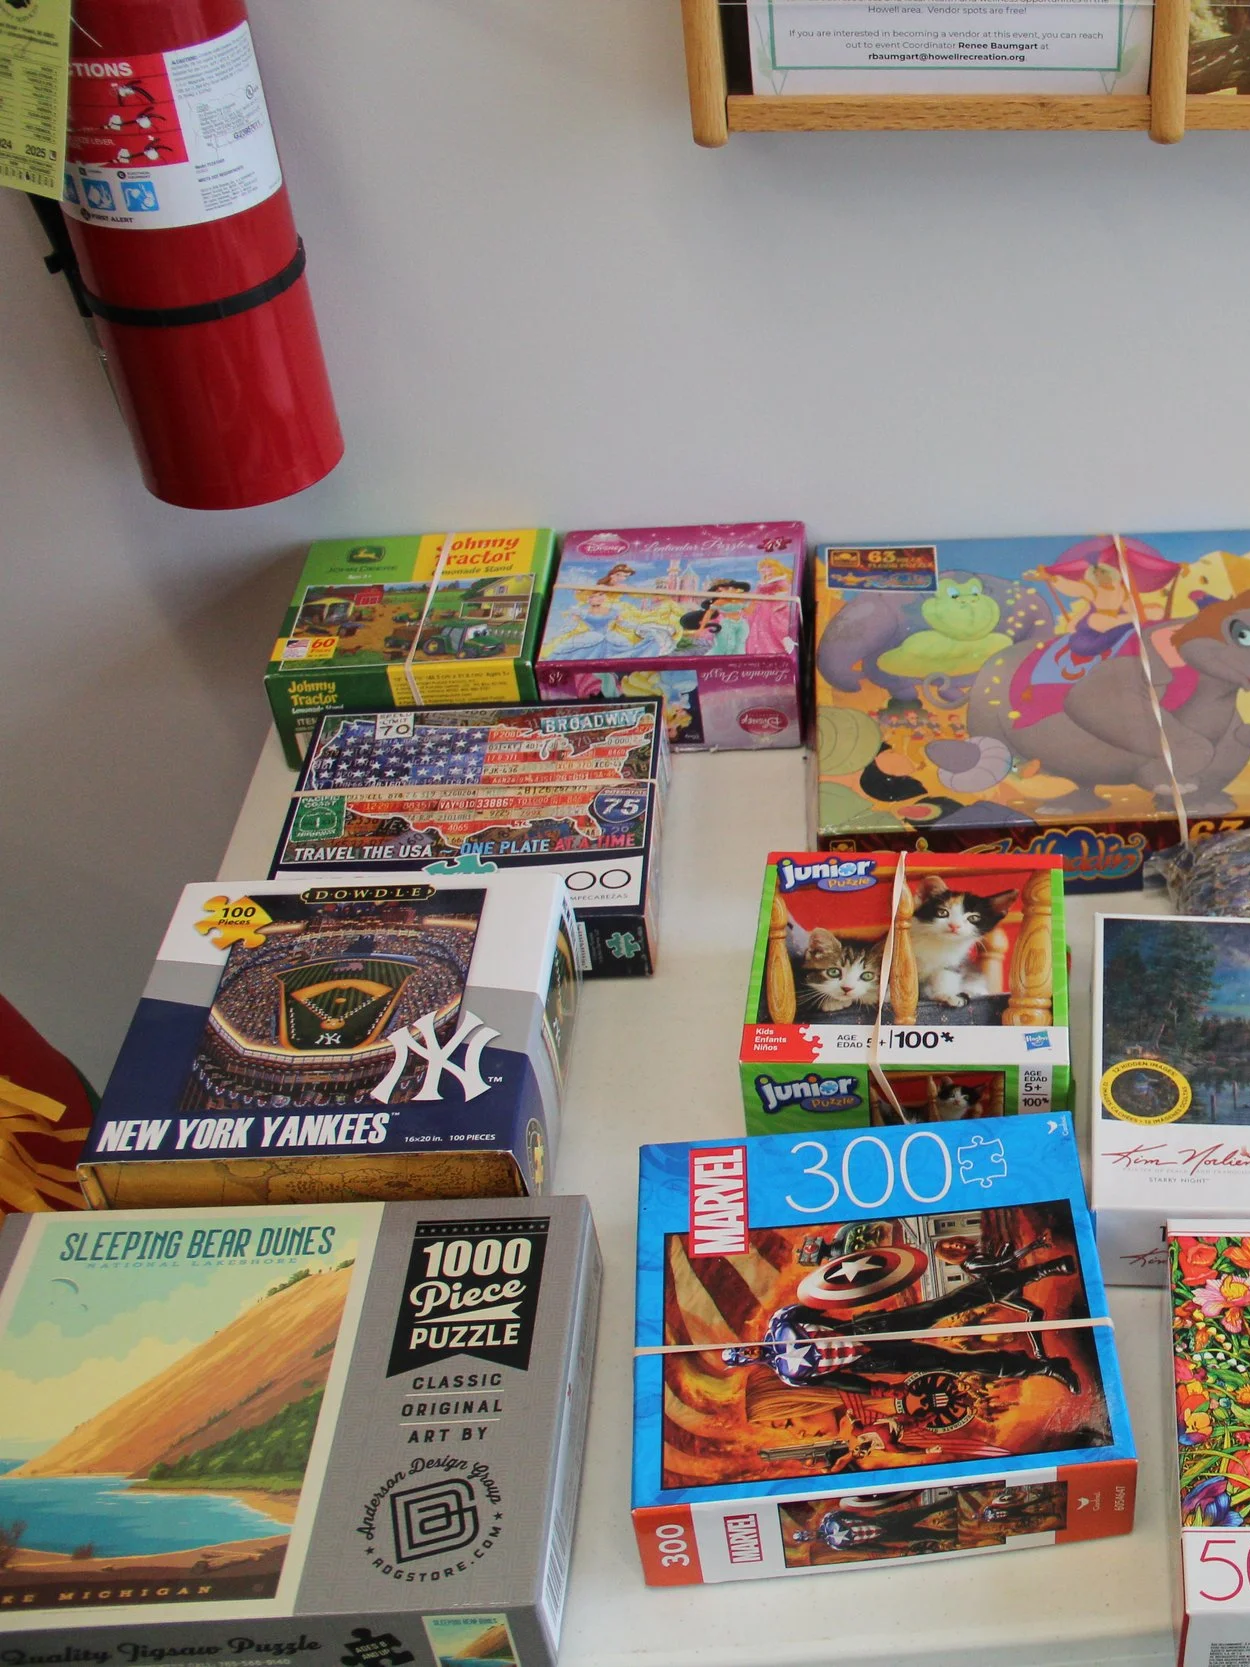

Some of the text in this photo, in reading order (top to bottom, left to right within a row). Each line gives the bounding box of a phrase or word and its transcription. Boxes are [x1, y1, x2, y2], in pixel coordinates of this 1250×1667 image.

[868, 6, 899, 14] Howell
[928, 6, 960, 14] Vendor
[962, 8, 987, 16] spots
[1006, 6, 1027, 15] free!
[798, 31, 814, 39] you
[833, 29, 880, 37] interested
[881, 29, 890, 37] in
[892, 29, 939, 40] becoming
[948, 30, 980, 38] vendor
[993, 30, 1011, 38] this
[1041, 32, 1058, 41] you
[1079, 31, 1103, 40] reach
[902, 41, 957, 49] Coordinator
[958, 42, 988, 50] Renee
[990, 42, 1038, 52] Baumgart
[868, 52, 1025, 63] rbaumgart@howellrecreation.org
[25, 143, 46, 158] 2025
[868, 551, 896, 562] 63
[312, 638, 336, 649] 60
[287, 680, 336, 695] Johnny
[290, 691, 338, 707] Tractor
[379, 723, 410, 736] 70
[545, 709, 644, 734] BROADWAY
[602, 799, 640, 816] 75
[294, 833, 636, 862] TRAVEL THE USA ONE PLATE AT A TIME
[570, 893, 629, 901] MPECABEZAS
[220, 905, 256, 920] 100
[218, 918, 251, 926] Pieces
[755, 1035, 787, 1044] Enfants
[756, 1027, 774, 1036] Kids
[837, 1034, 858, 1042] AGE
[753, 1043, 778, 1051] Niños
[895, 1031, 939, 1049] 100
[1121, 1061, 1175, 1077] HIDDEN IMAGES
[1024, 1083, 1042, 1092] 5+
[1022, 1097, 1042, 1107] 100
[96, 1111, 390, 1153] NEW YORK YANKEES
[449, 1133, 496, 1142] 100 PIECES
[1101, 1143, 1177, 1168] Kim
[785, 1131, 954, 1213] 300
[693, 1148, 746, 1255] MARVEL
[61, 1225, 336, 1262] SLEEPING BEAR DUNES
[86, 1257, 298, 1269] NATIONAL LAKESHORE
[423, 1238, 531, 1278] 1000
[410, 1278, 527, 1318] Piece
[409, 1322, 521, 1350] PUZZLE
[412, 1373, 502, 1390] CLASSIC
[401, 1400, 503, 1417] ORIGINAL
[408, 1427, 487, 1443] ART BY
[356, 1455, 502, 1541] Anderson Design Group
[656, 1523, 690, 1569] 300
[726, 1514, 763, 1564] MARVEL
[58, 1585, 213, 1602] MICHIGAN
[2, 1633, 322, 1666] Quality Jigsaw Puzzle
[355, 1643, 379, 1655] AGES
